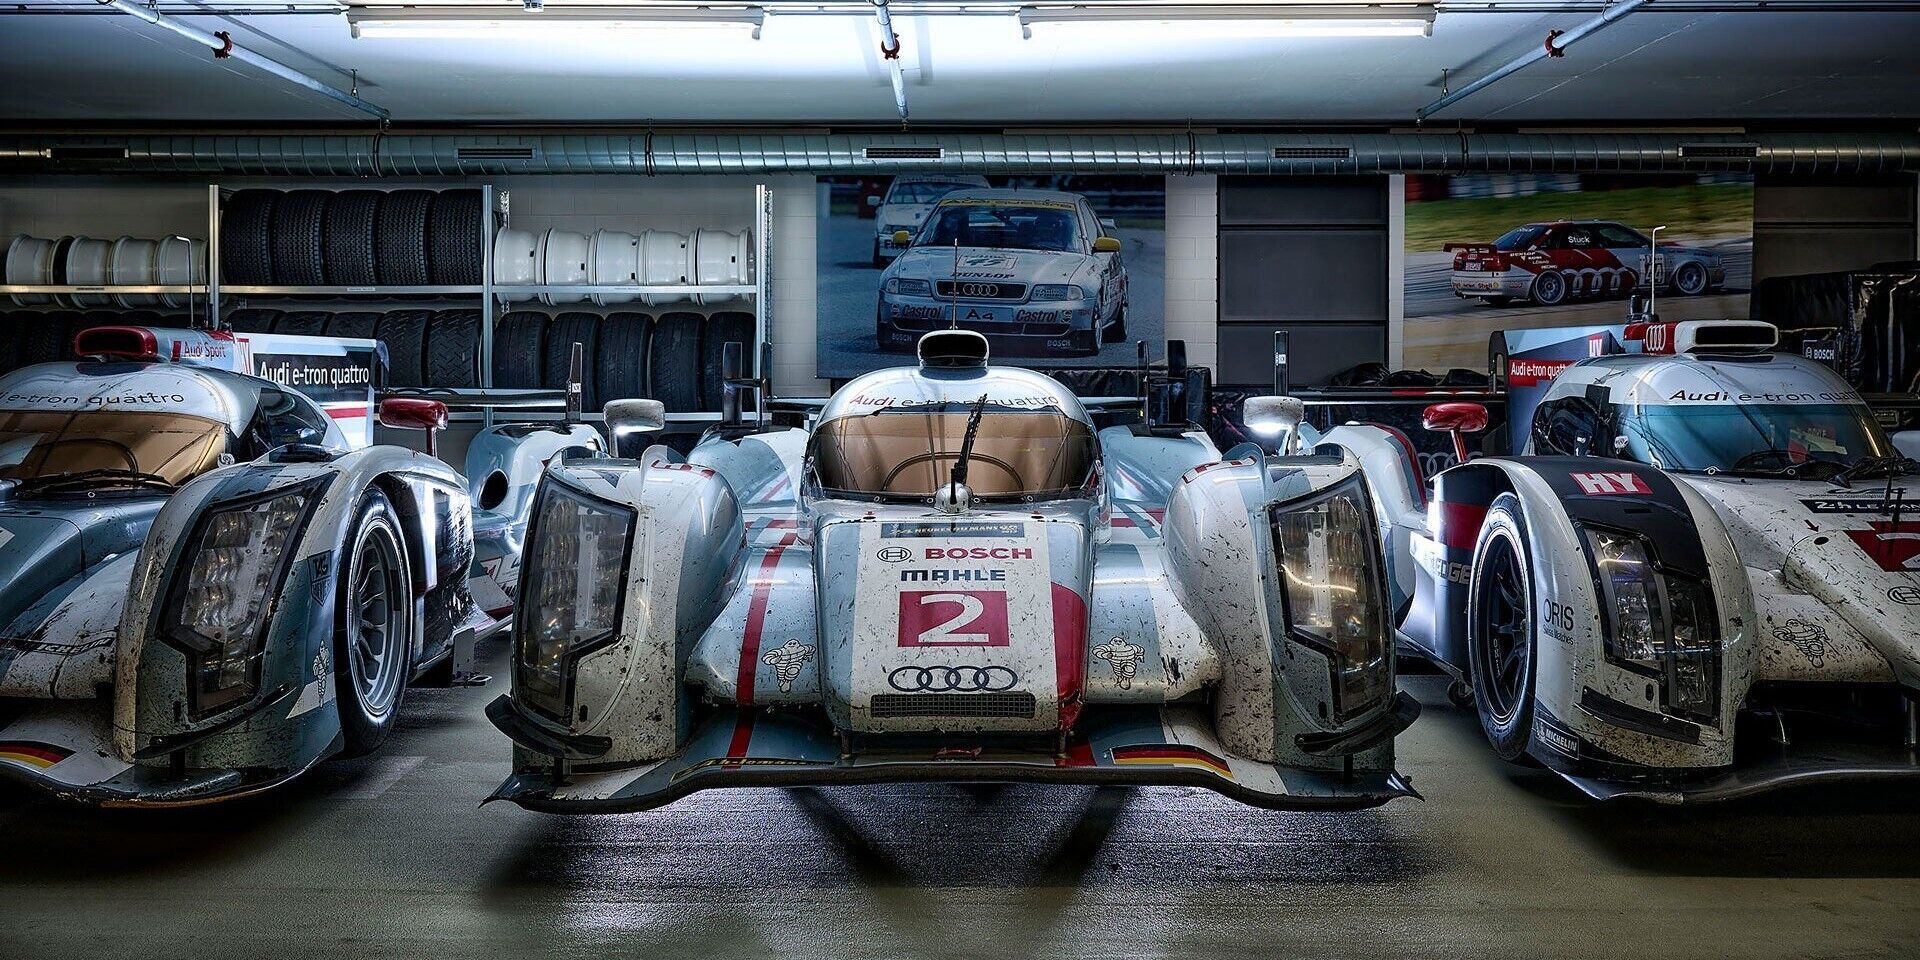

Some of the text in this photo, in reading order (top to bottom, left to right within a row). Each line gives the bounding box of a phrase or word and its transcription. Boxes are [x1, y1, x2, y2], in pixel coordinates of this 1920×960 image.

[1567, 235, 1590, 244] Stuck
[903, 304, 943, 319] Castrol
[965, 308, 995, 321] A4
[1016, 308, 1059, 322] Castrol
[184, 341, 203, 357] Audi
[204, 342, 227, 359] Sport
[1046, 339, 1071, 348] BOSCH
[1813, 349, 1835, 360] BOSCH
[260, 361, 370, 389] Audi e-tron quattro
[1510, 361, 1526, 376] Audi
[1527, 364, 1547, 377] e-tron
[7, 394, 79, 404] e-tron
[88, 392, 185, 405] quattro
[850, 394, 897, 406] Audi
[1669, 390, 1730, 401] Audi
[1739, 391, 1816, 402] e-tron
[1572, 472, 1639, 493] HY
[925, 547, 1033, 559] BOSCH
[900, 569, 1006, 582] MAHLE
[918, 593, 989, 642] 2
[1543, 598, 1575, 631] ORIS
[33, 637, 114, 655] ICHELIN
[1545, 728, 1578, 752] MICHELIN
